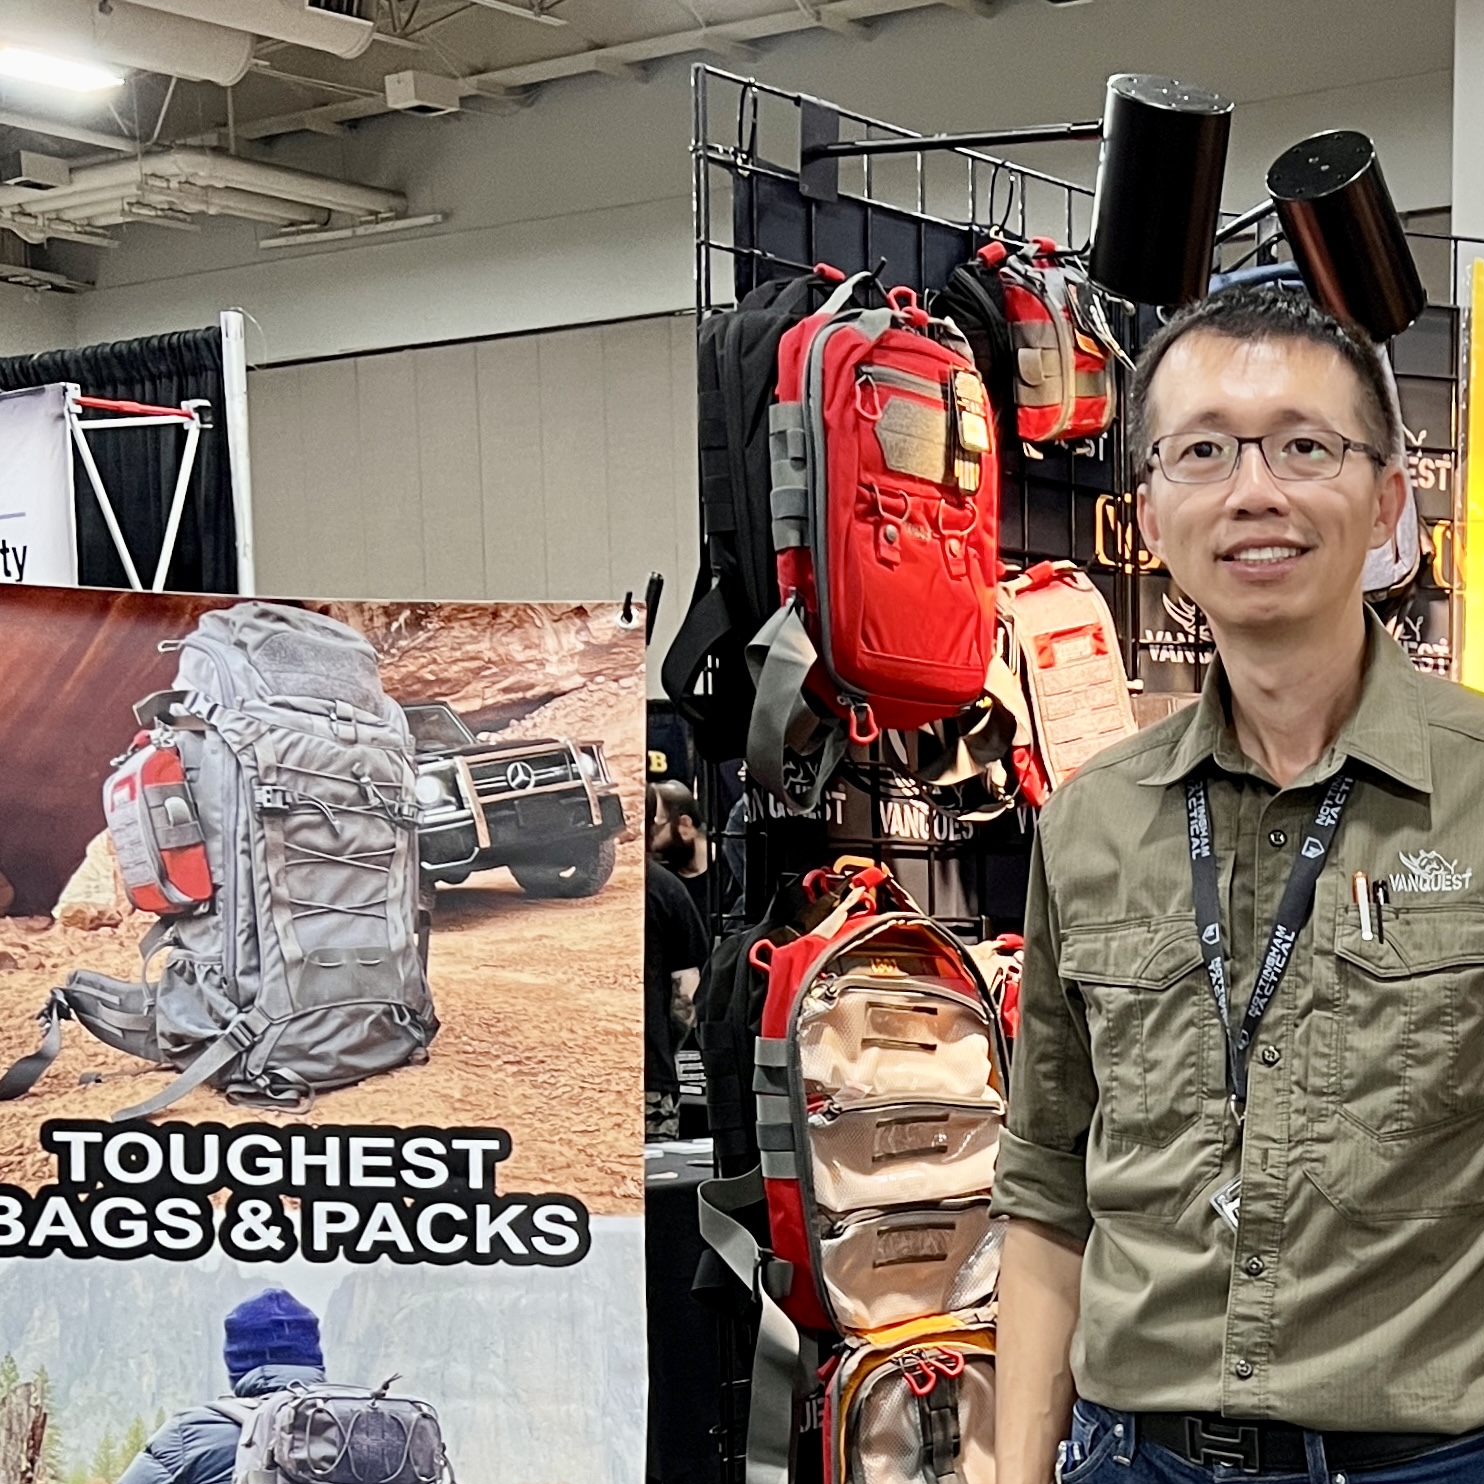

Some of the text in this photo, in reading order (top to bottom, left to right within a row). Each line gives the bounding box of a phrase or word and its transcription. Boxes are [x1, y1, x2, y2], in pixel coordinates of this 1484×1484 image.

[1388, 870, 1473, 893] VANQUEST
[1247, 923, 1288, 1019] NOTTINGHAM
[1251, 930, 1296, 1021] TACTICAL
[52, 1130, 501, 1191] TOUGHEST
[0, 1195, 580, 1257] BAGS & PACKS
